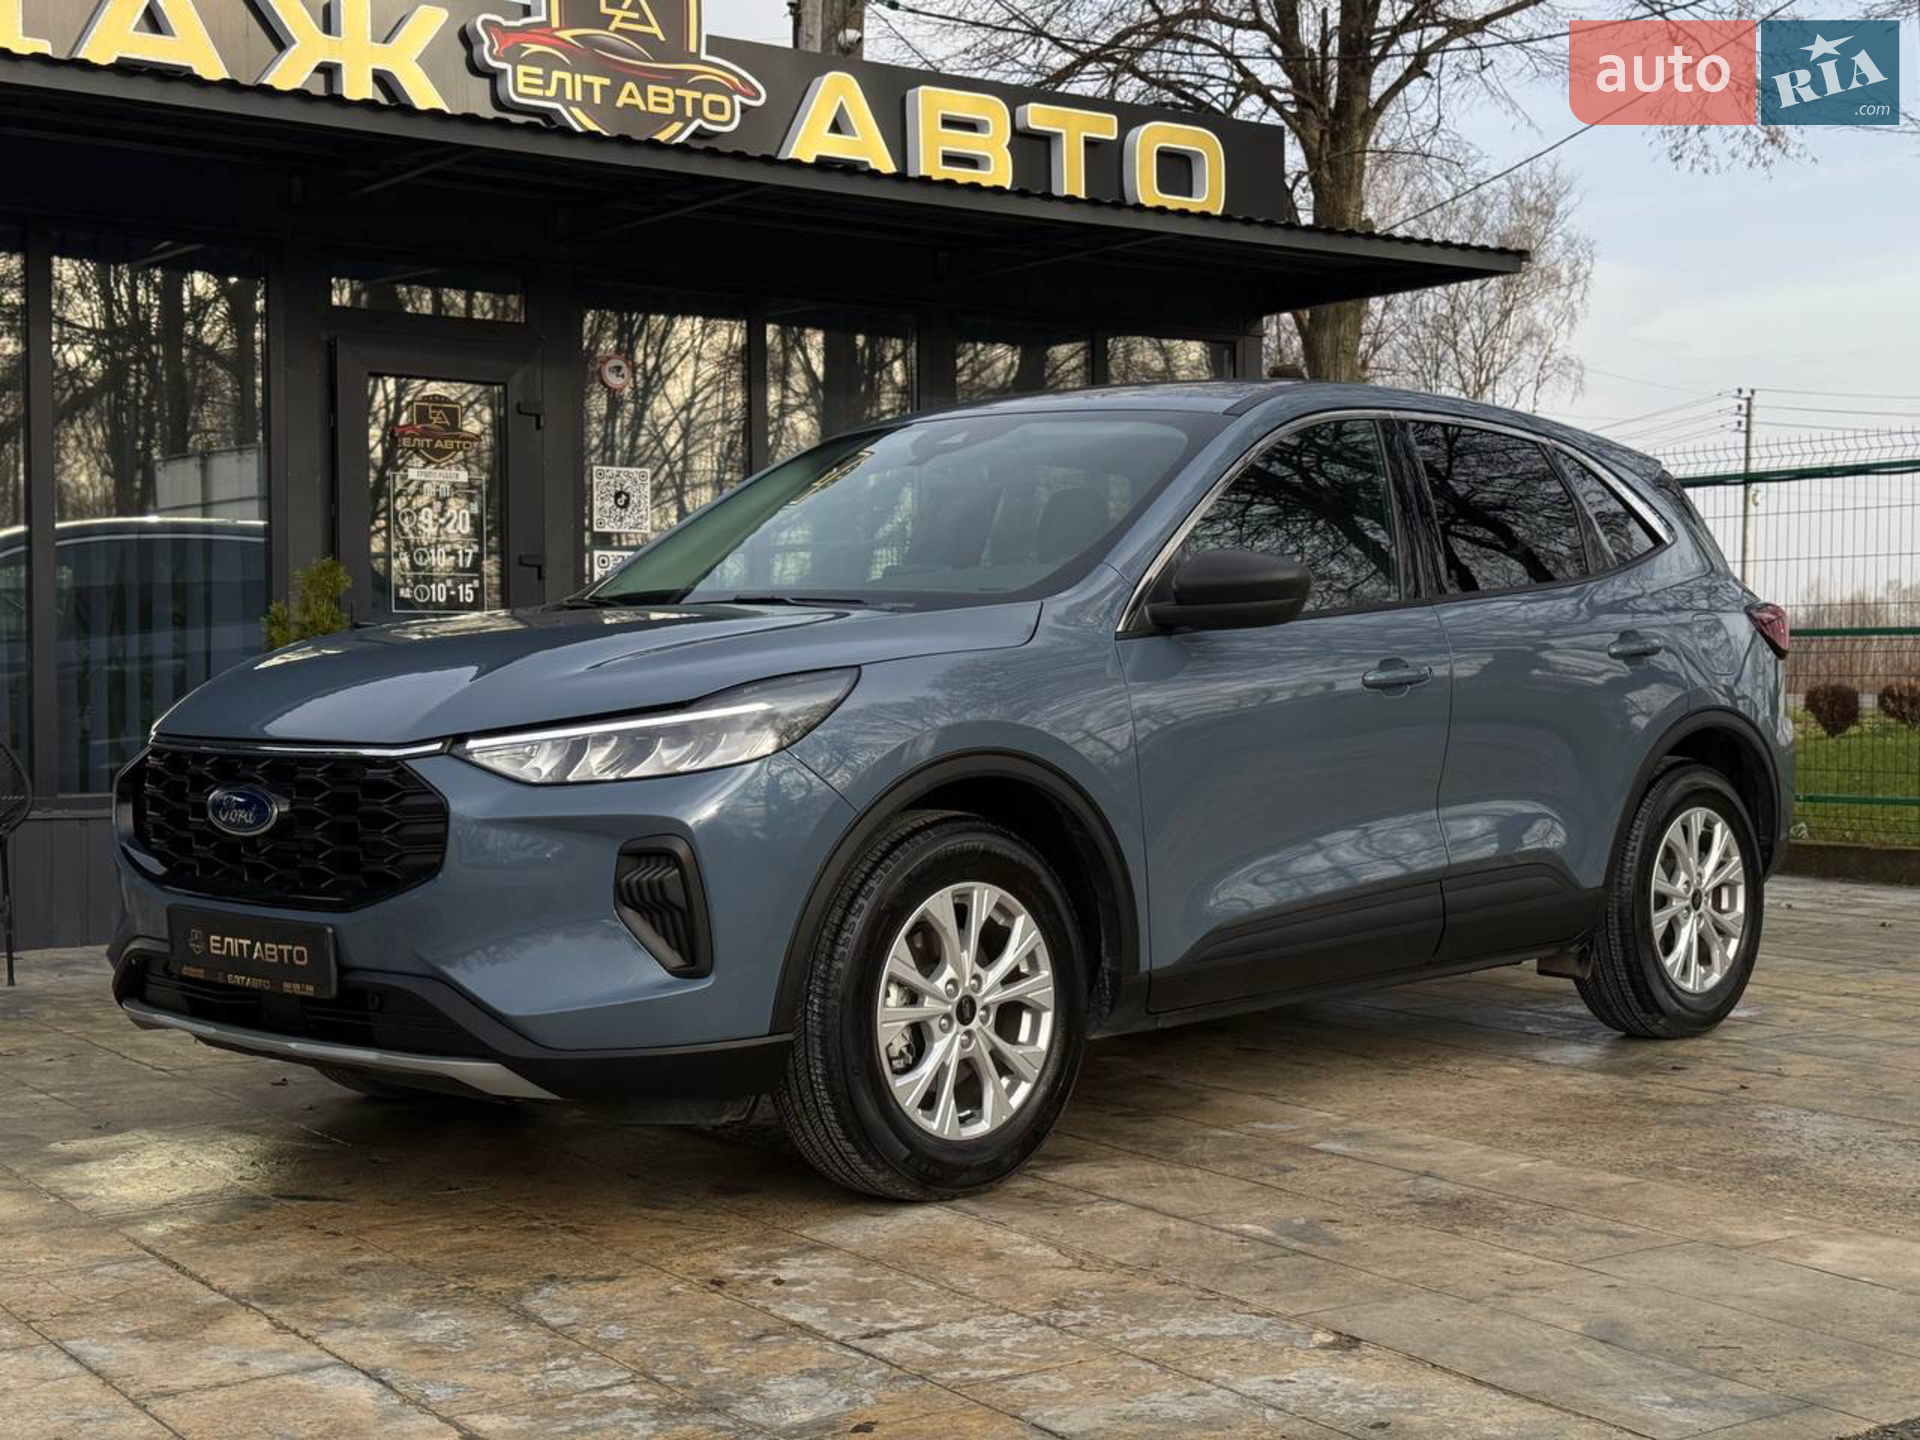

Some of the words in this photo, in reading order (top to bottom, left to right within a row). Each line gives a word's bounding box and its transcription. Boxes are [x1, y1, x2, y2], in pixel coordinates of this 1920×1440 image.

[516, 64, 611, 105] ЕЛІТ
[614, 81, 733, 122] АВТО
[780, 71, 1226, 216] АВТО
[402, 437, 432, 448] ЕЛІТ
[434, 439, 473, 451] АВТО
[213, 793, 257, 826] Ford
